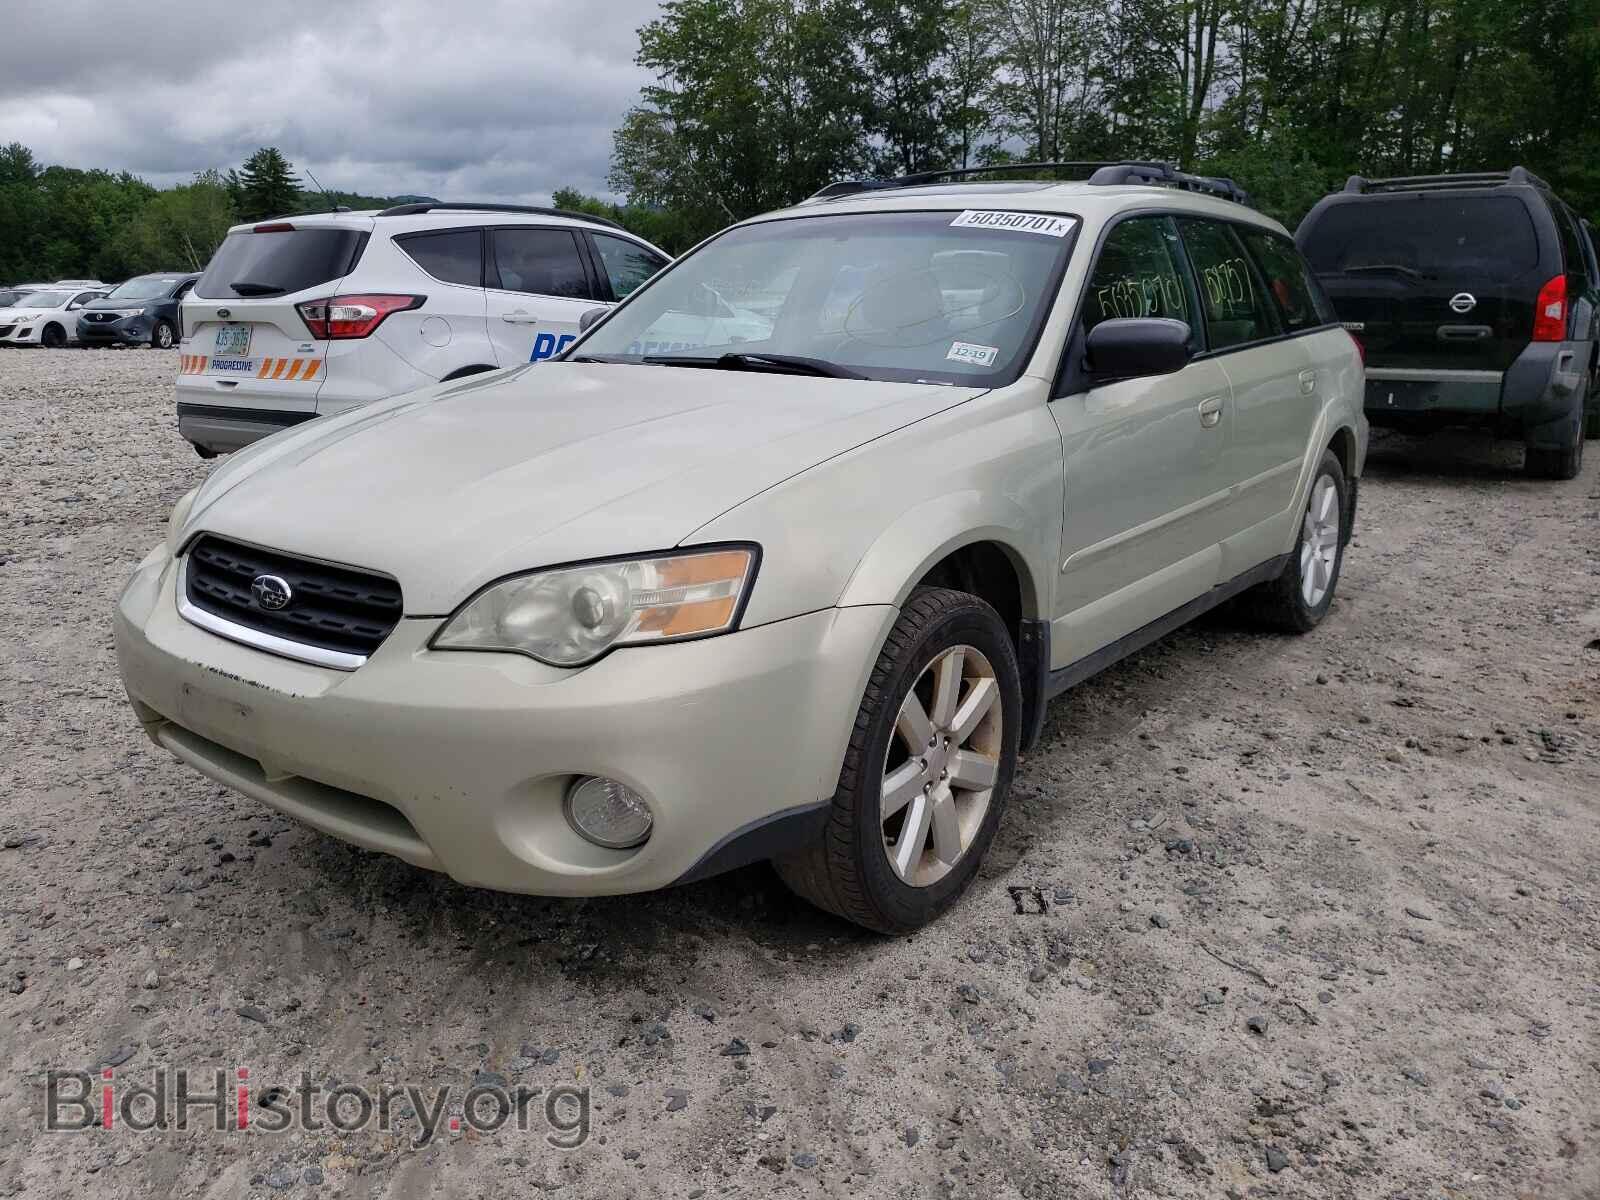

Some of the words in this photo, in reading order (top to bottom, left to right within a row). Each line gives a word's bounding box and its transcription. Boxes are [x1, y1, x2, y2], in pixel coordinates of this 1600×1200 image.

[967, 212, 1057, 231] 50350701
[953, 348, 986, 359] 12-19
[211, 359, 253, 371] PROGRESSIVE
